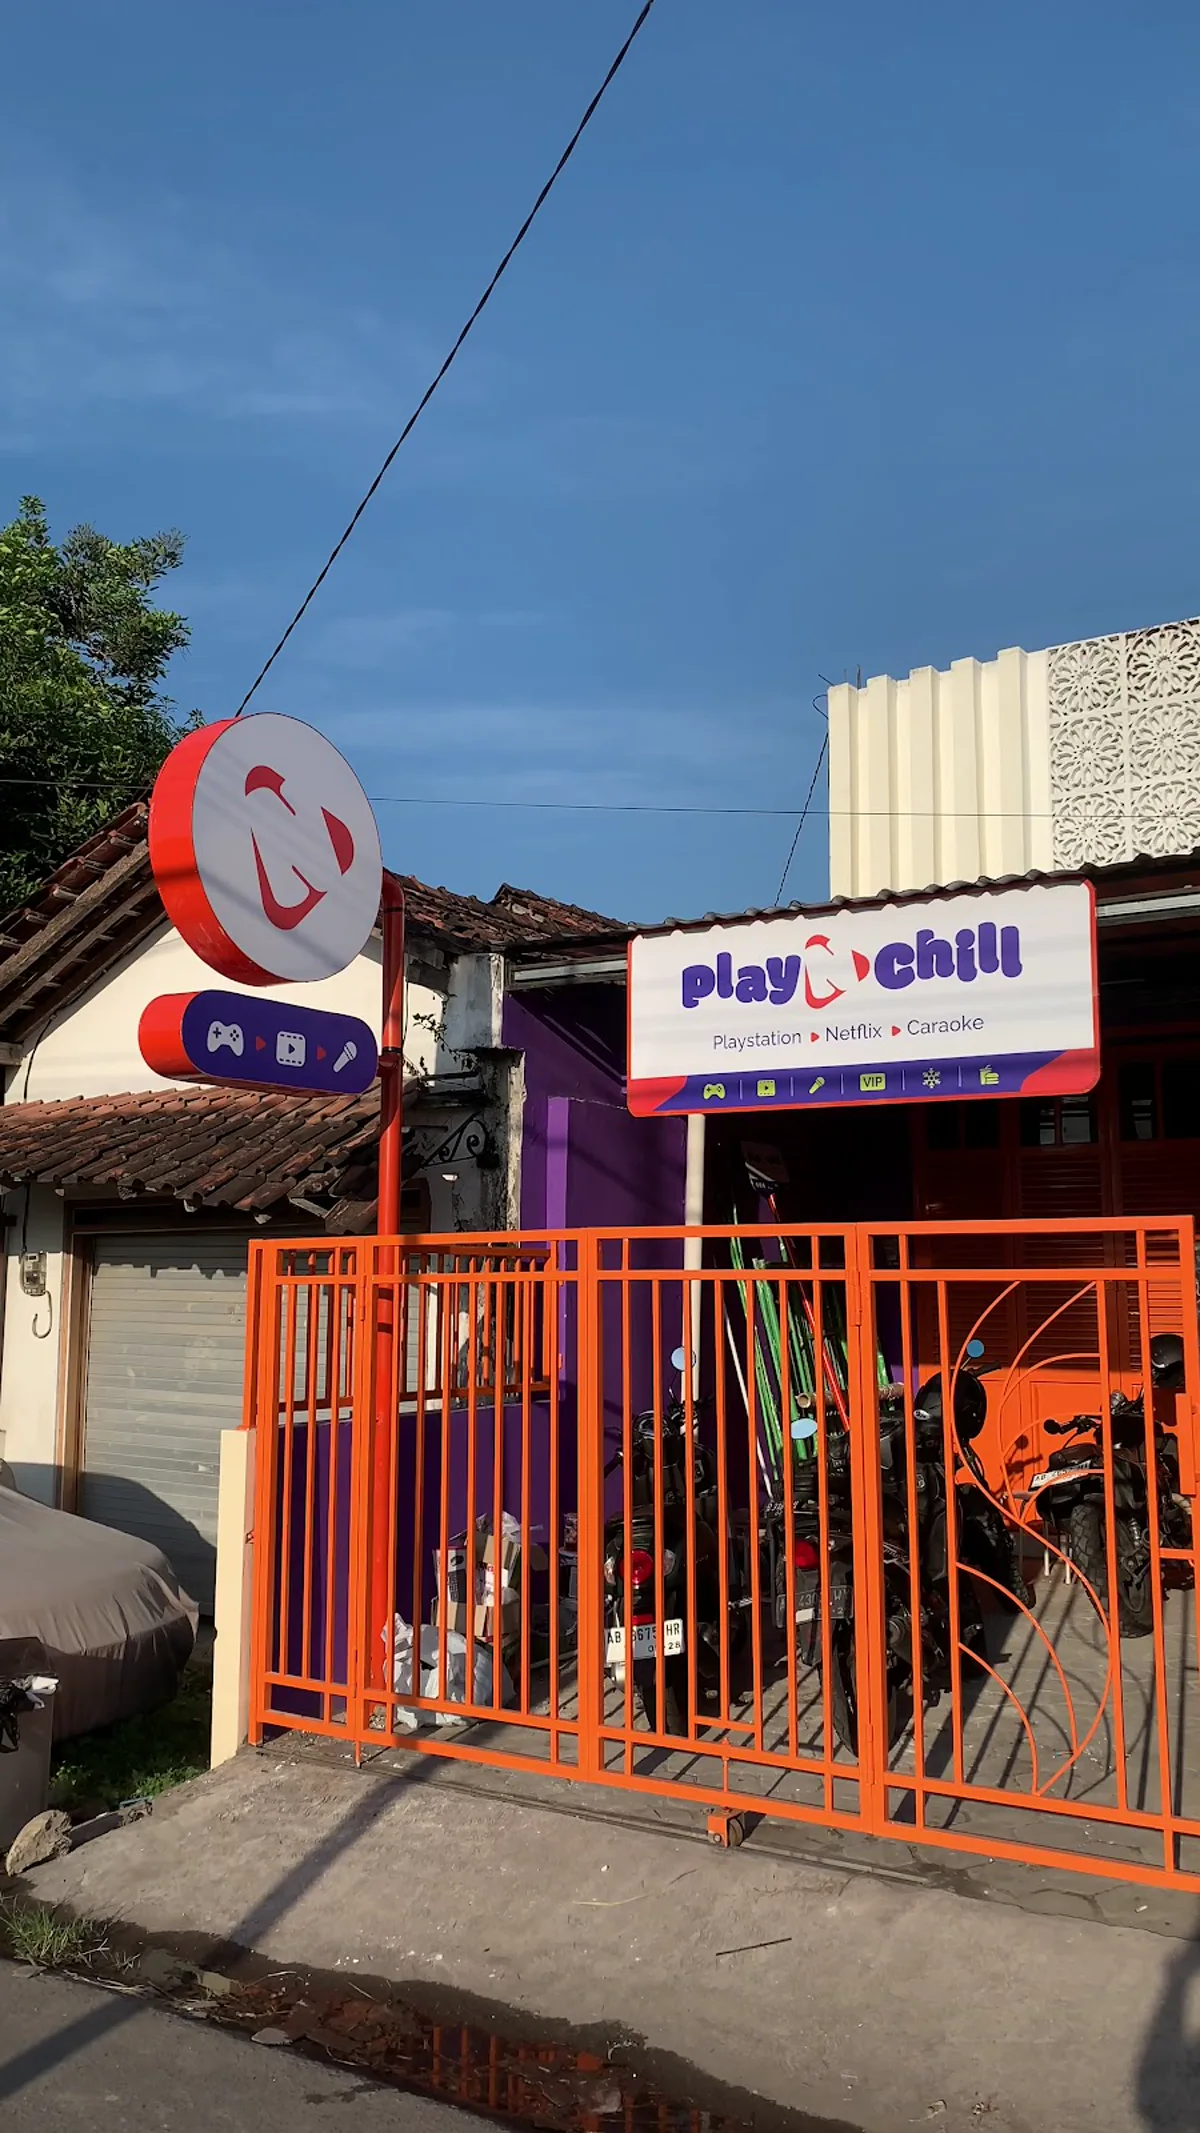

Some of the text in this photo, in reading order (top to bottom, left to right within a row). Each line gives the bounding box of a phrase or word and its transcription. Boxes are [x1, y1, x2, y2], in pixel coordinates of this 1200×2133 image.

[682, 952, 801, 1009] play
[874, 921, 1023, 990] chill
[713, 1014, 985, 1052] Playstation Netflix Caraoke
[863, 1076, 883, 1088] VIP
[607, 1631, 622, 1644] AB
[666, 1623, 680, 1636] HR
